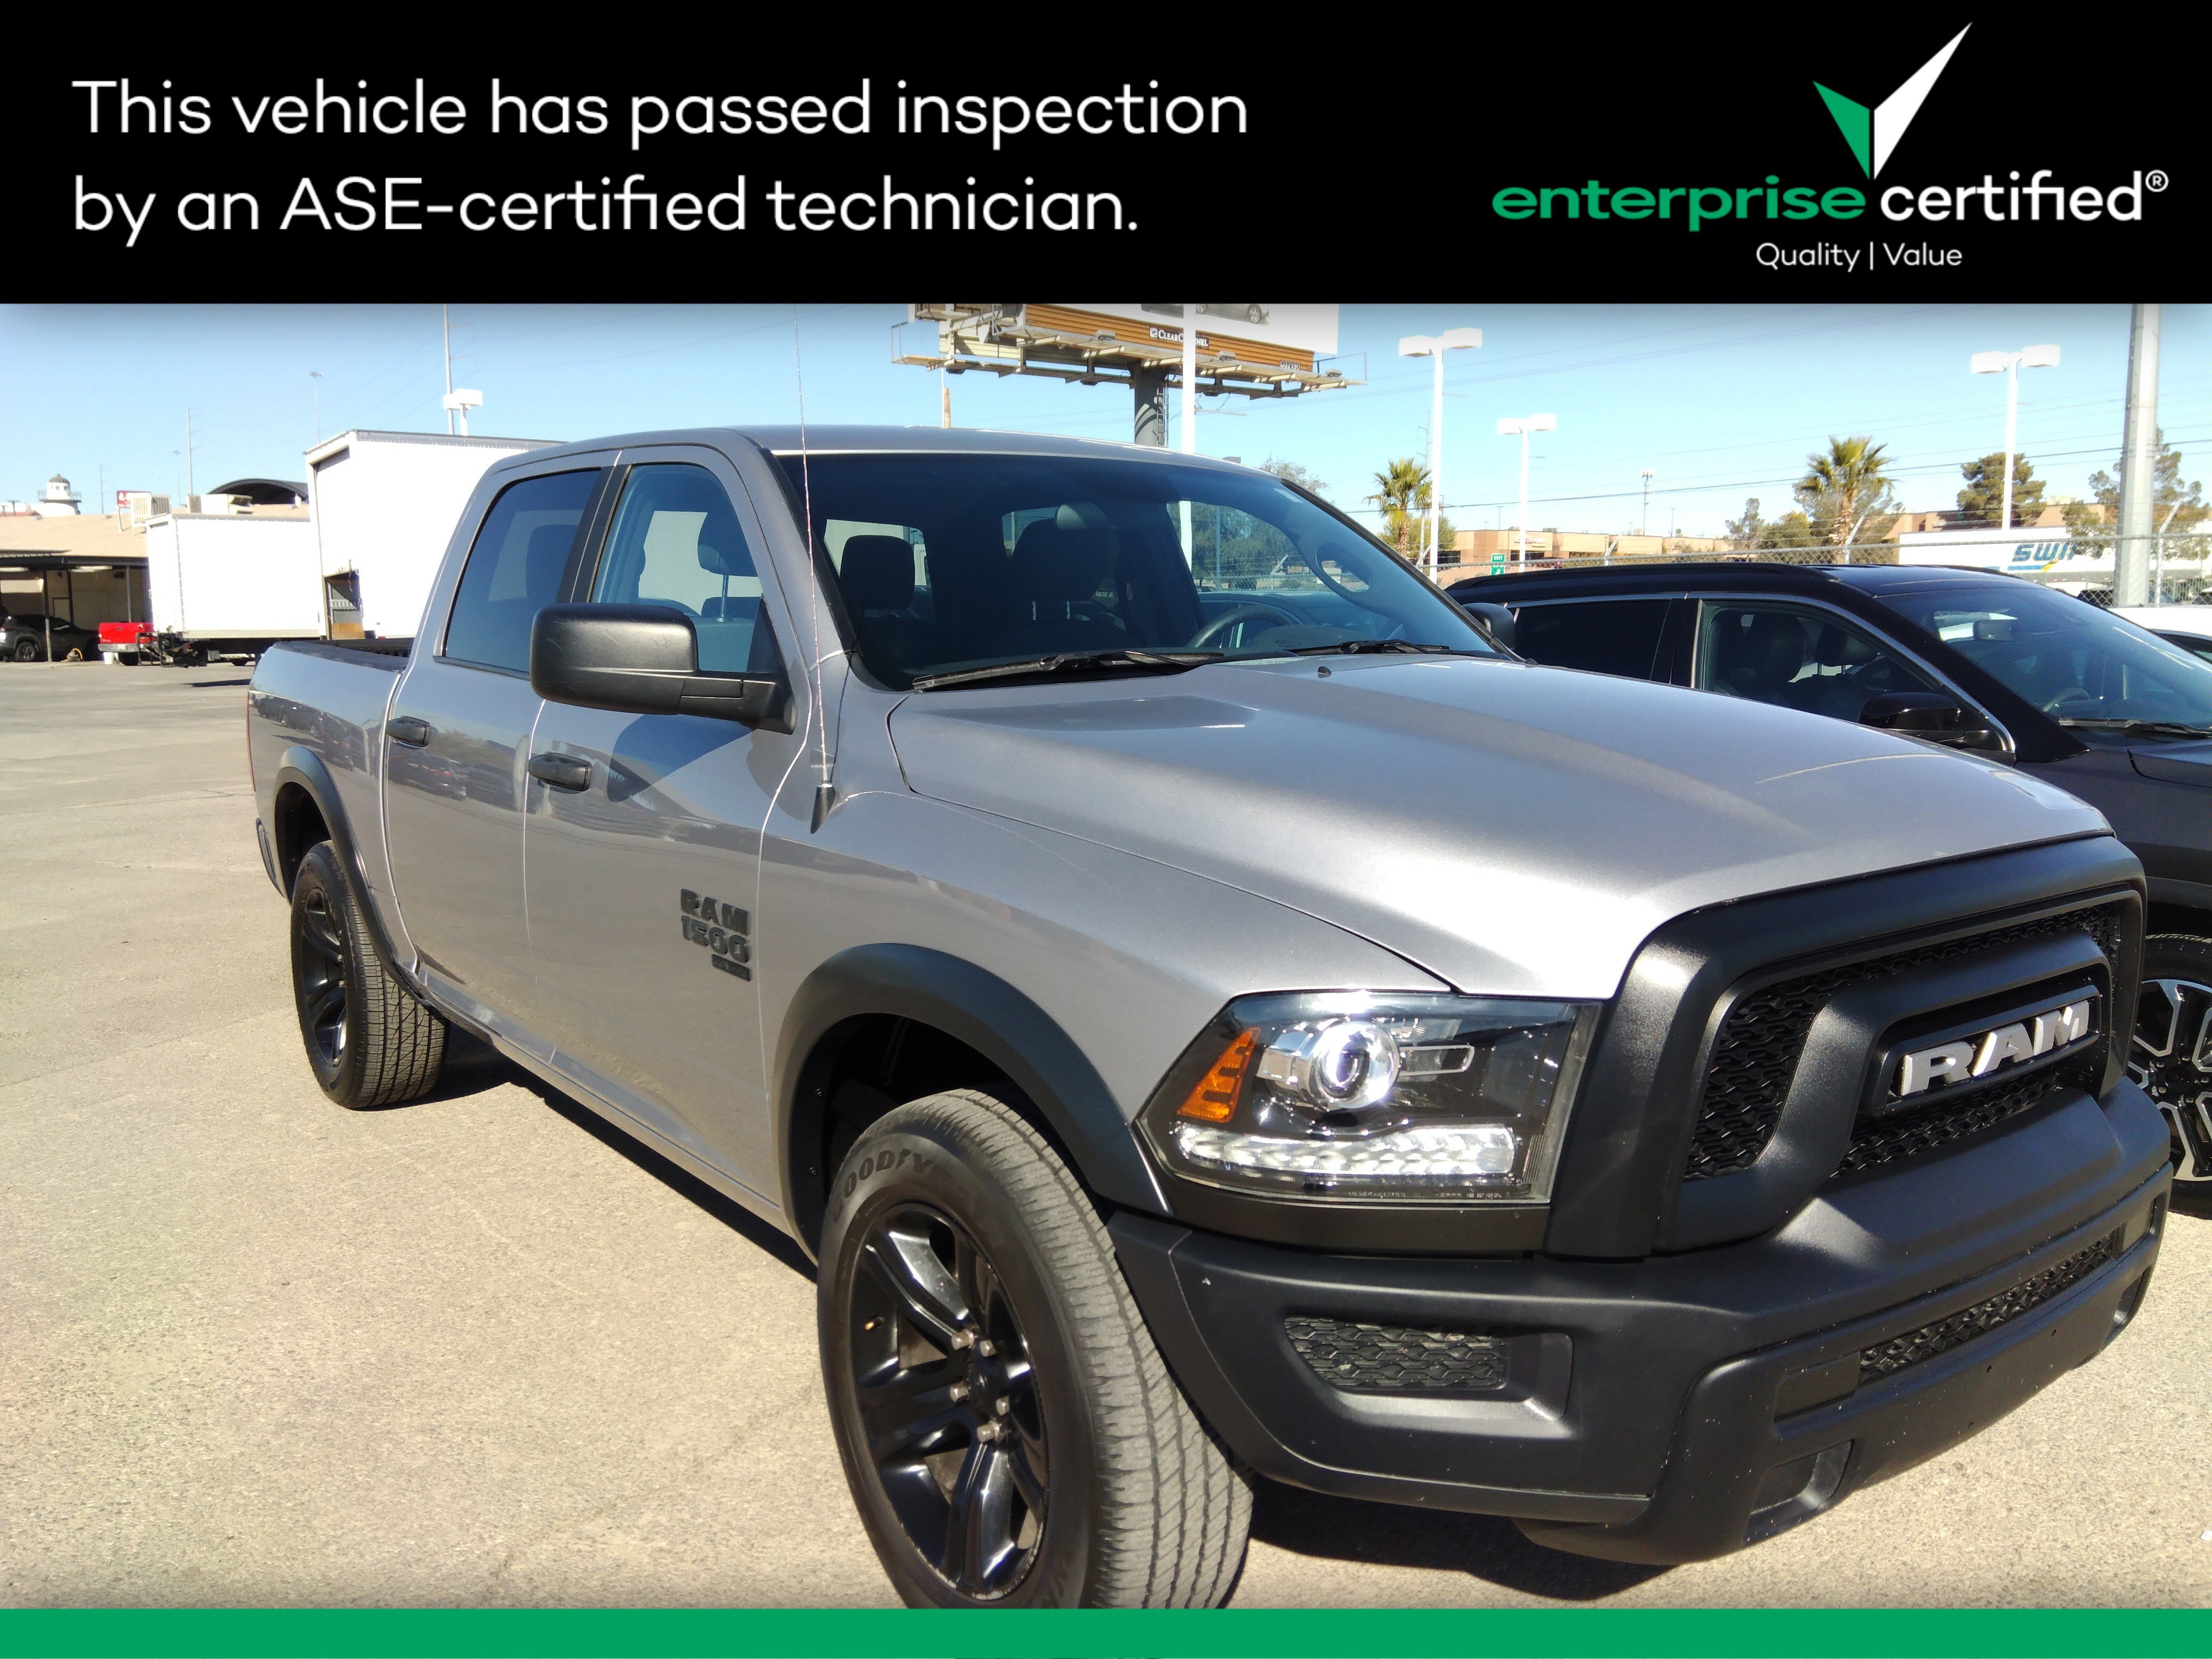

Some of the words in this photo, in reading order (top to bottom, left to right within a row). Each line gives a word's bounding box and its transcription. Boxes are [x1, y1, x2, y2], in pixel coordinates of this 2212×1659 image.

[681, 889, 749, 936] RAM
[681, 915, 750, 963] 1500
[1900, 1000, 2090, 1096] RAM
